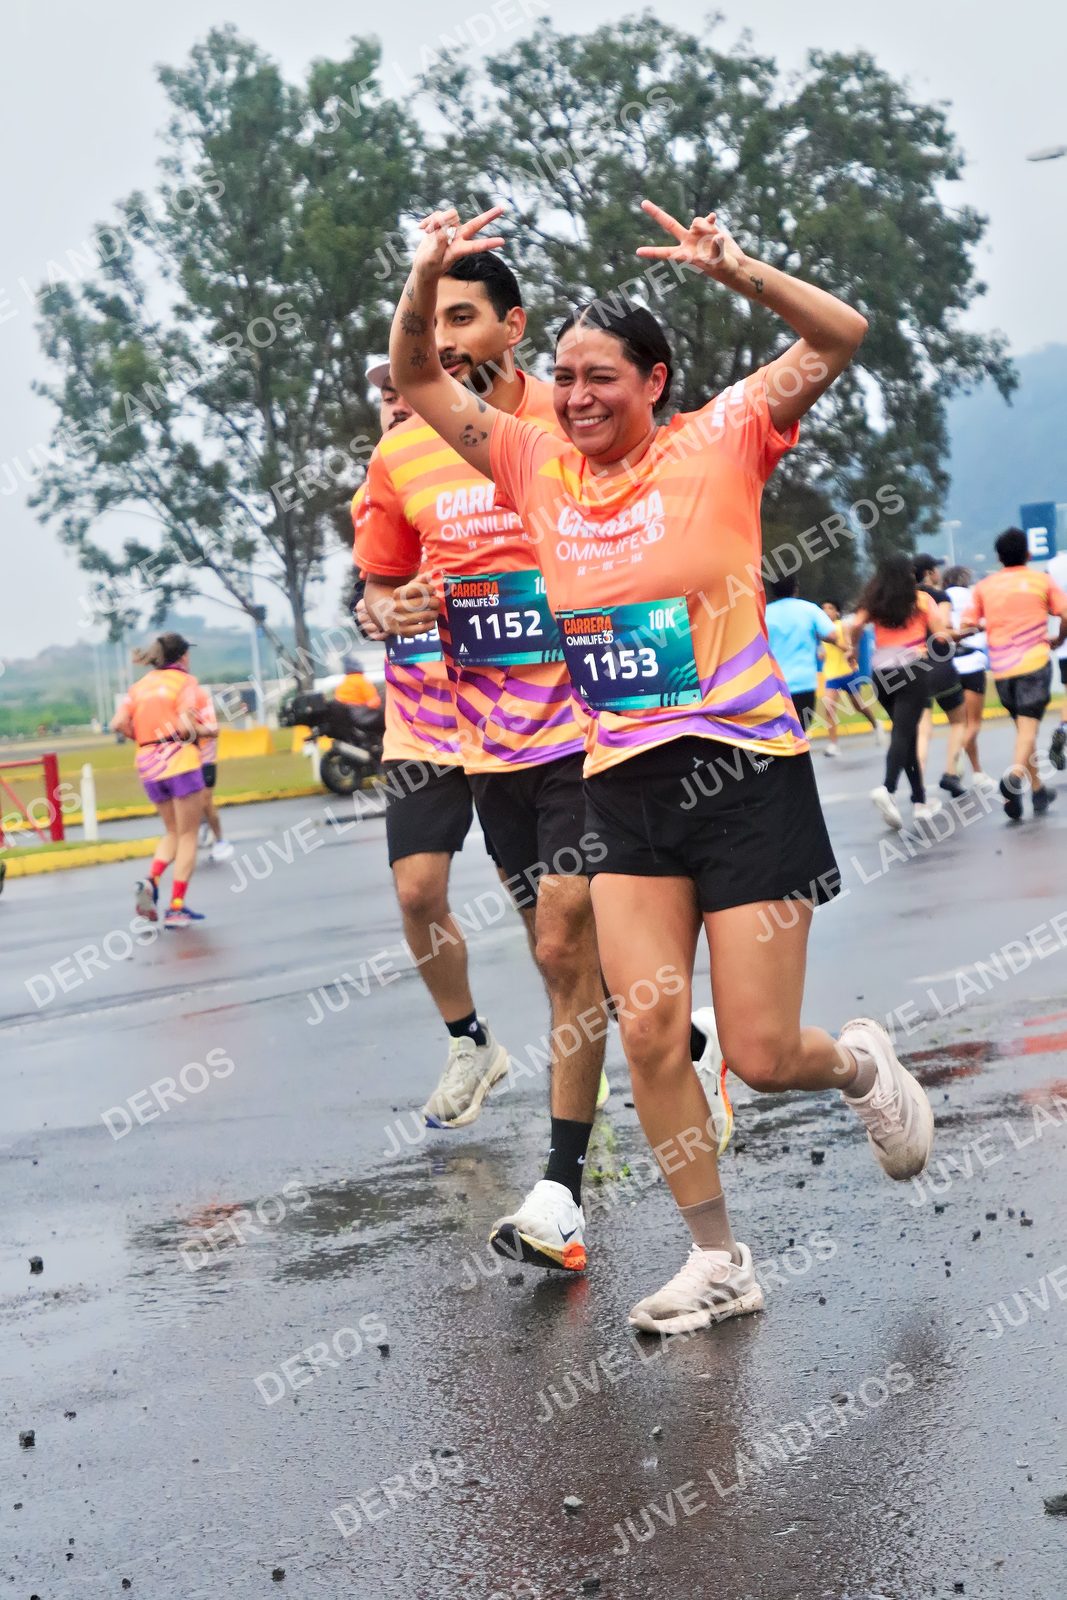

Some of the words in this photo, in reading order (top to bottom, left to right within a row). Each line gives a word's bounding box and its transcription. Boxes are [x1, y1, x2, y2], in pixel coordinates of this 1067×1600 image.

[556, 532, 640, 561] OMNILIFE
[1027, 527, 1050, 557] E
[450, 581, 499, 598] CARRERA
[468, 610, 544, 640] 1152
[563, 616, 613, 635] CARRERA
[648, 606, 678, 630] 10K
[566, 634, 603, 646] OMNILIFE
[583, 647, 660, 682] 1153
